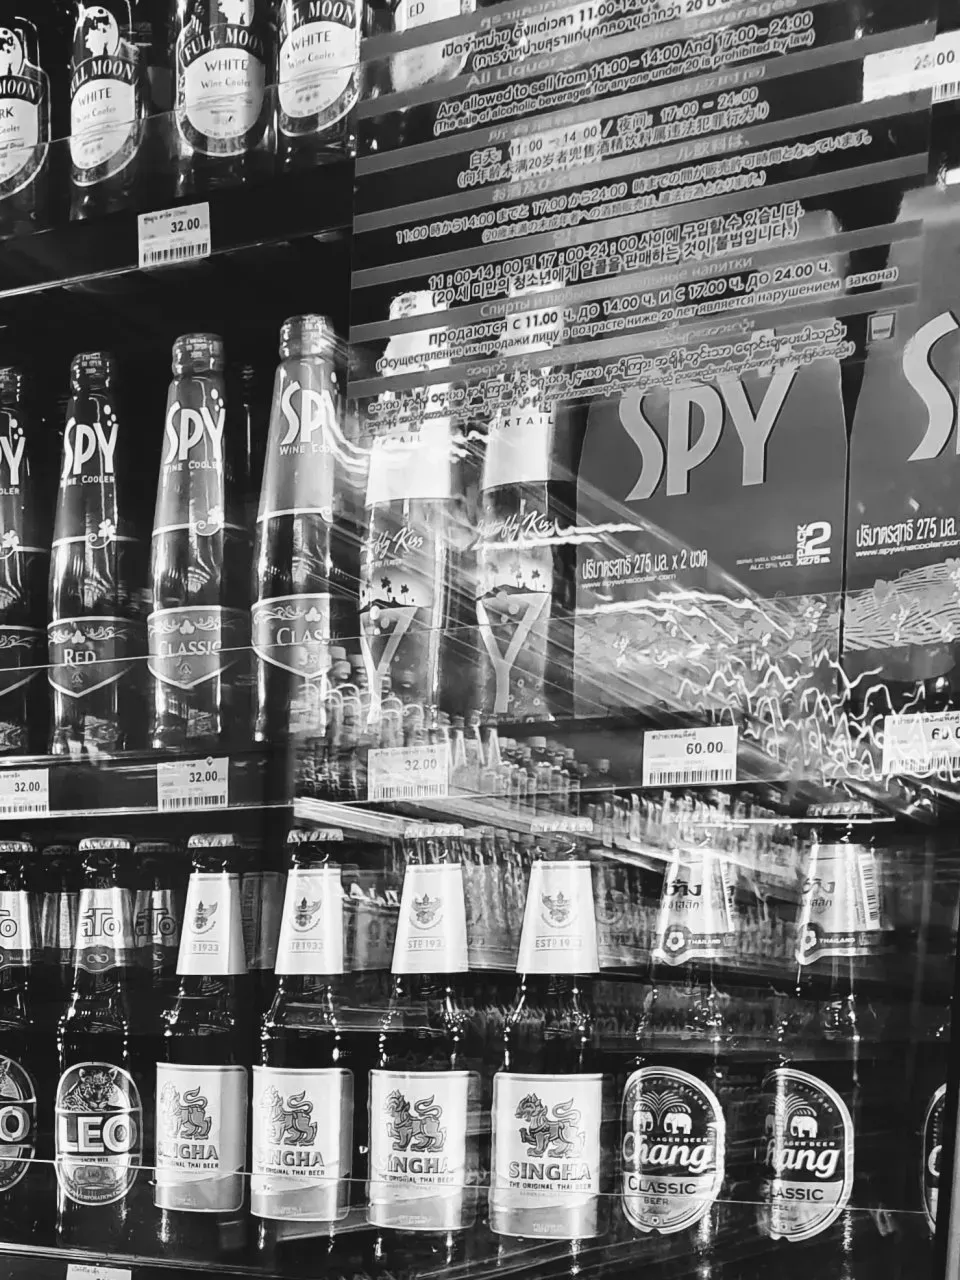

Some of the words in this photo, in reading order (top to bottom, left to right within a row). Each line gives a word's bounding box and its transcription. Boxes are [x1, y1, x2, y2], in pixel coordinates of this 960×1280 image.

[307, 0, 354, 24] MOON
[290, 29, 332, 52] WHITE
[91, 59, 136, 81] MOON
[204, 58, 249, 73] WHITE
[437, 101, 460, 119] Are
[462, 87, 514, 112] allowed
[514, 83, 529, 99] to
[530, 74, 554, 95] sell
[555, 68, 589, 90] from
[591, 57, 630, 81] 11:00
[641, 44, 681, 68] 14:00
[682, 38, 713, 61] And
[716, 24, 758, 50] 17:00
[768, 11, 814, 36] 24:00
[434, 120, 456, 137] (The
[457, 114, 479, 129] sale
[479, 111, 491, 123] of
[491, 97, 537, 120] alcoholic
[538, 84, 593, 108] beverages
[593, 80, 609, 94] for
[610, 70, 651, 93] anyone
[651, 62, 684, 81] under
[684, 56, 700, 72] 20
[701, 55, 711, 68] is
[712, 40, 772, 69] prohibited
[772, 36, 789, 54] by
[789, 28, 816, 49] law)
[77, 87, 113, 107] WHITE
[170, 217, 201, 234] 32.00
[166, 400, 227, 463] SPY
[618, 369, 797, 502] SPY
[61, 416, 120, 480] SPY
[279, 443, 306, 456] WINE
[81, 474, 116, 484] COOLER
[804, 521, 832, 556] 2
[916, 518, 937, 540] 275
[392, 528, 425, 555] Kiss
[796, 524, 808, 560] PACK
[634, 554, 652, 575] 275
[681, 552, 688, 568] 2
[63, 648, 97, 667] RED
[157, 639, 223, 659] CLASSIC
[685, 740, 724, 755] 60.00
[405, 758, 438, 772] 32.00
[189, 769, 220, 783] 32.00
[14, 781, 41, 793] 32.00
[58, 1115, 137, 1154] LEO
[623, 1131, 713, 1174] Chang
[308, 1168, 326, 1176] BEER
[419, 1176, 436, 1184] THAI
[507, 1160, 592, 1181] SINGHA
[509, 1181, 521, 1189] THE
[523, 1181, 555, 1190] ORIGINAL
[556, 1182, 573, 1190] THAI
[575, 1183, 592, 1191] BEER
[628, 1174, 697, 1195] CLASSIC
[644, 1197, 669, 1205] BEER
